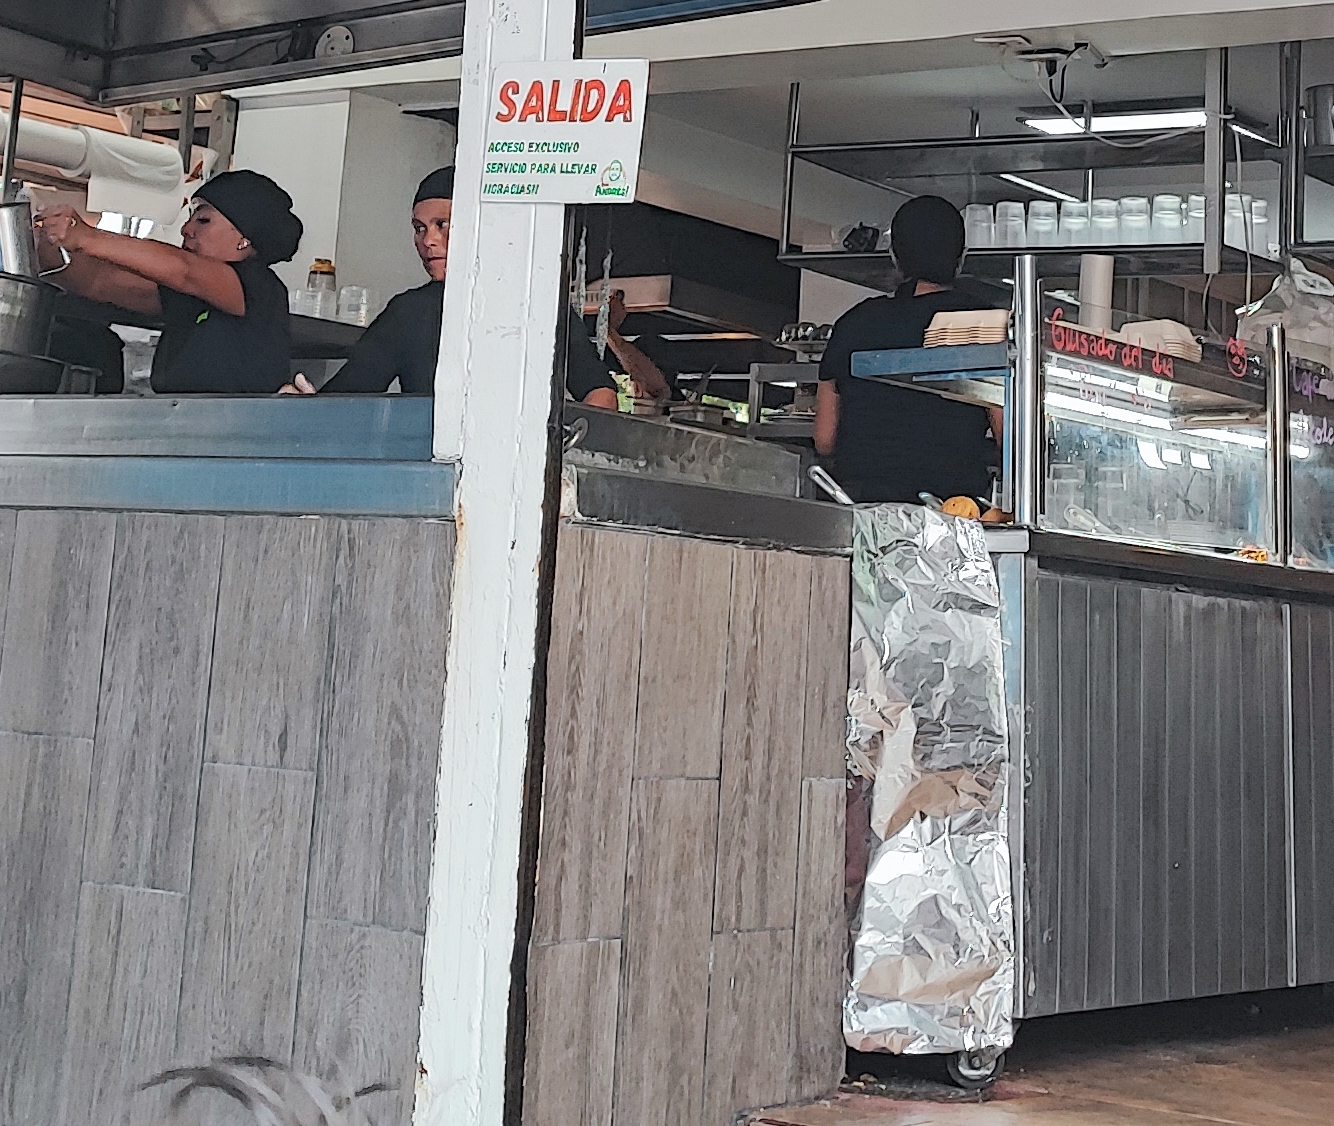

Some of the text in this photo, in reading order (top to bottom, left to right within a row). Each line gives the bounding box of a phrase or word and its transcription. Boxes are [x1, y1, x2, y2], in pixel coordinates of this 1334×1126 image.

[495, 78, 633, 123] SALIDA
[487, 141, 580, 153] ACCESO EXCLUSIVO
[485, 162, 598, 175] SERVICIO PARA LLEVAR
[1121, 336, 1143, 369] del
